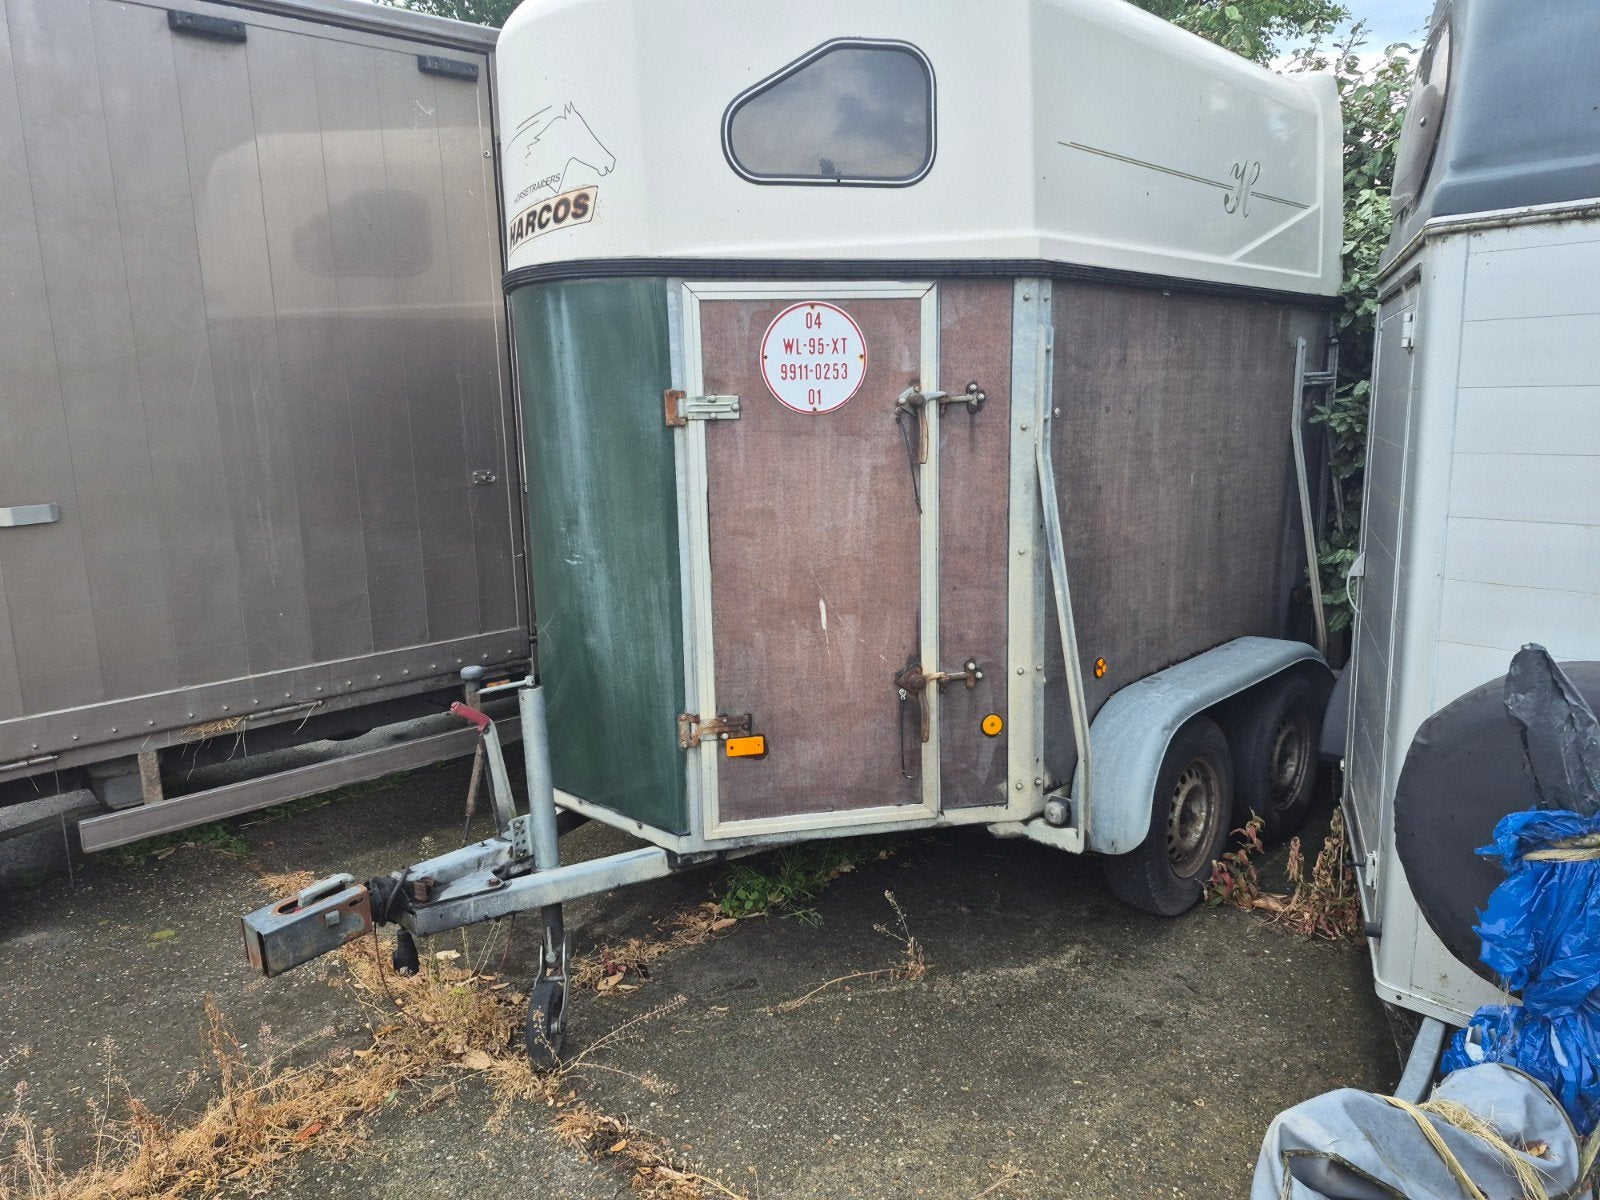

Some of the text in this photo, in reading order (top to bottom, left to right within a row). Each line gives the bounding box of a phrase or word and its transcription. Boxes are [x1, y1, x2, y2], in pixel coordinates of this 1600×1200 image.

[805, 311, 823, 329] 04
[782, 337, 848, 355] WL-95-XT
[780, 362, 848, 381] 9911-0253
[807, 388, 822, 405] 01
